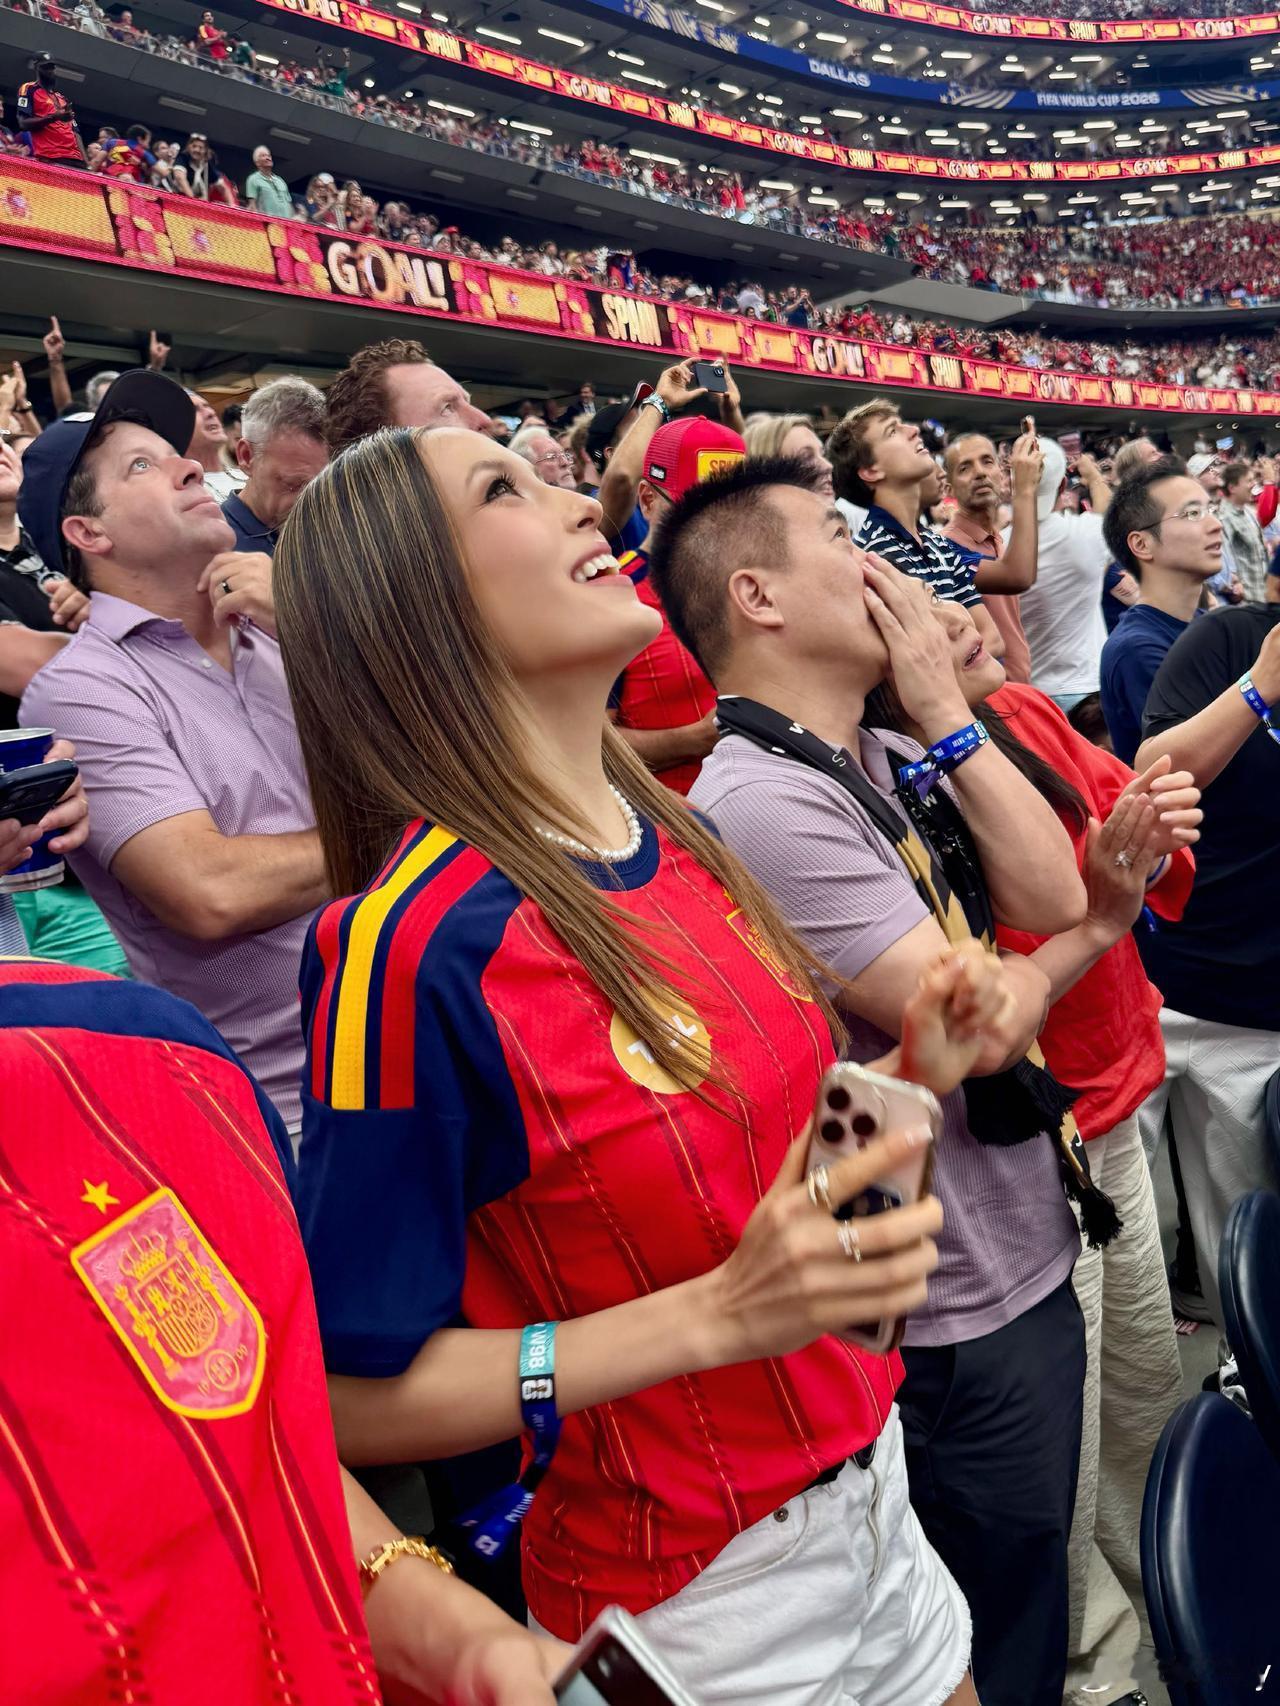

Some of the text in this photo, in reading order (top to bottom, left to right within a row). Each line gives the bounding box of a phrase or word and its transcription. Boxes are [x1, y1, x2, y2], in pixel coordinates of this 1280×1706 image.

[808, 59, 871, 87] DALLAS
[1037, 92, 1160, 107] FIFA WORLD CUP 2026
[328, 241, 449, 312] GOAL!
[601, 293, 662, 347] SPAIN
